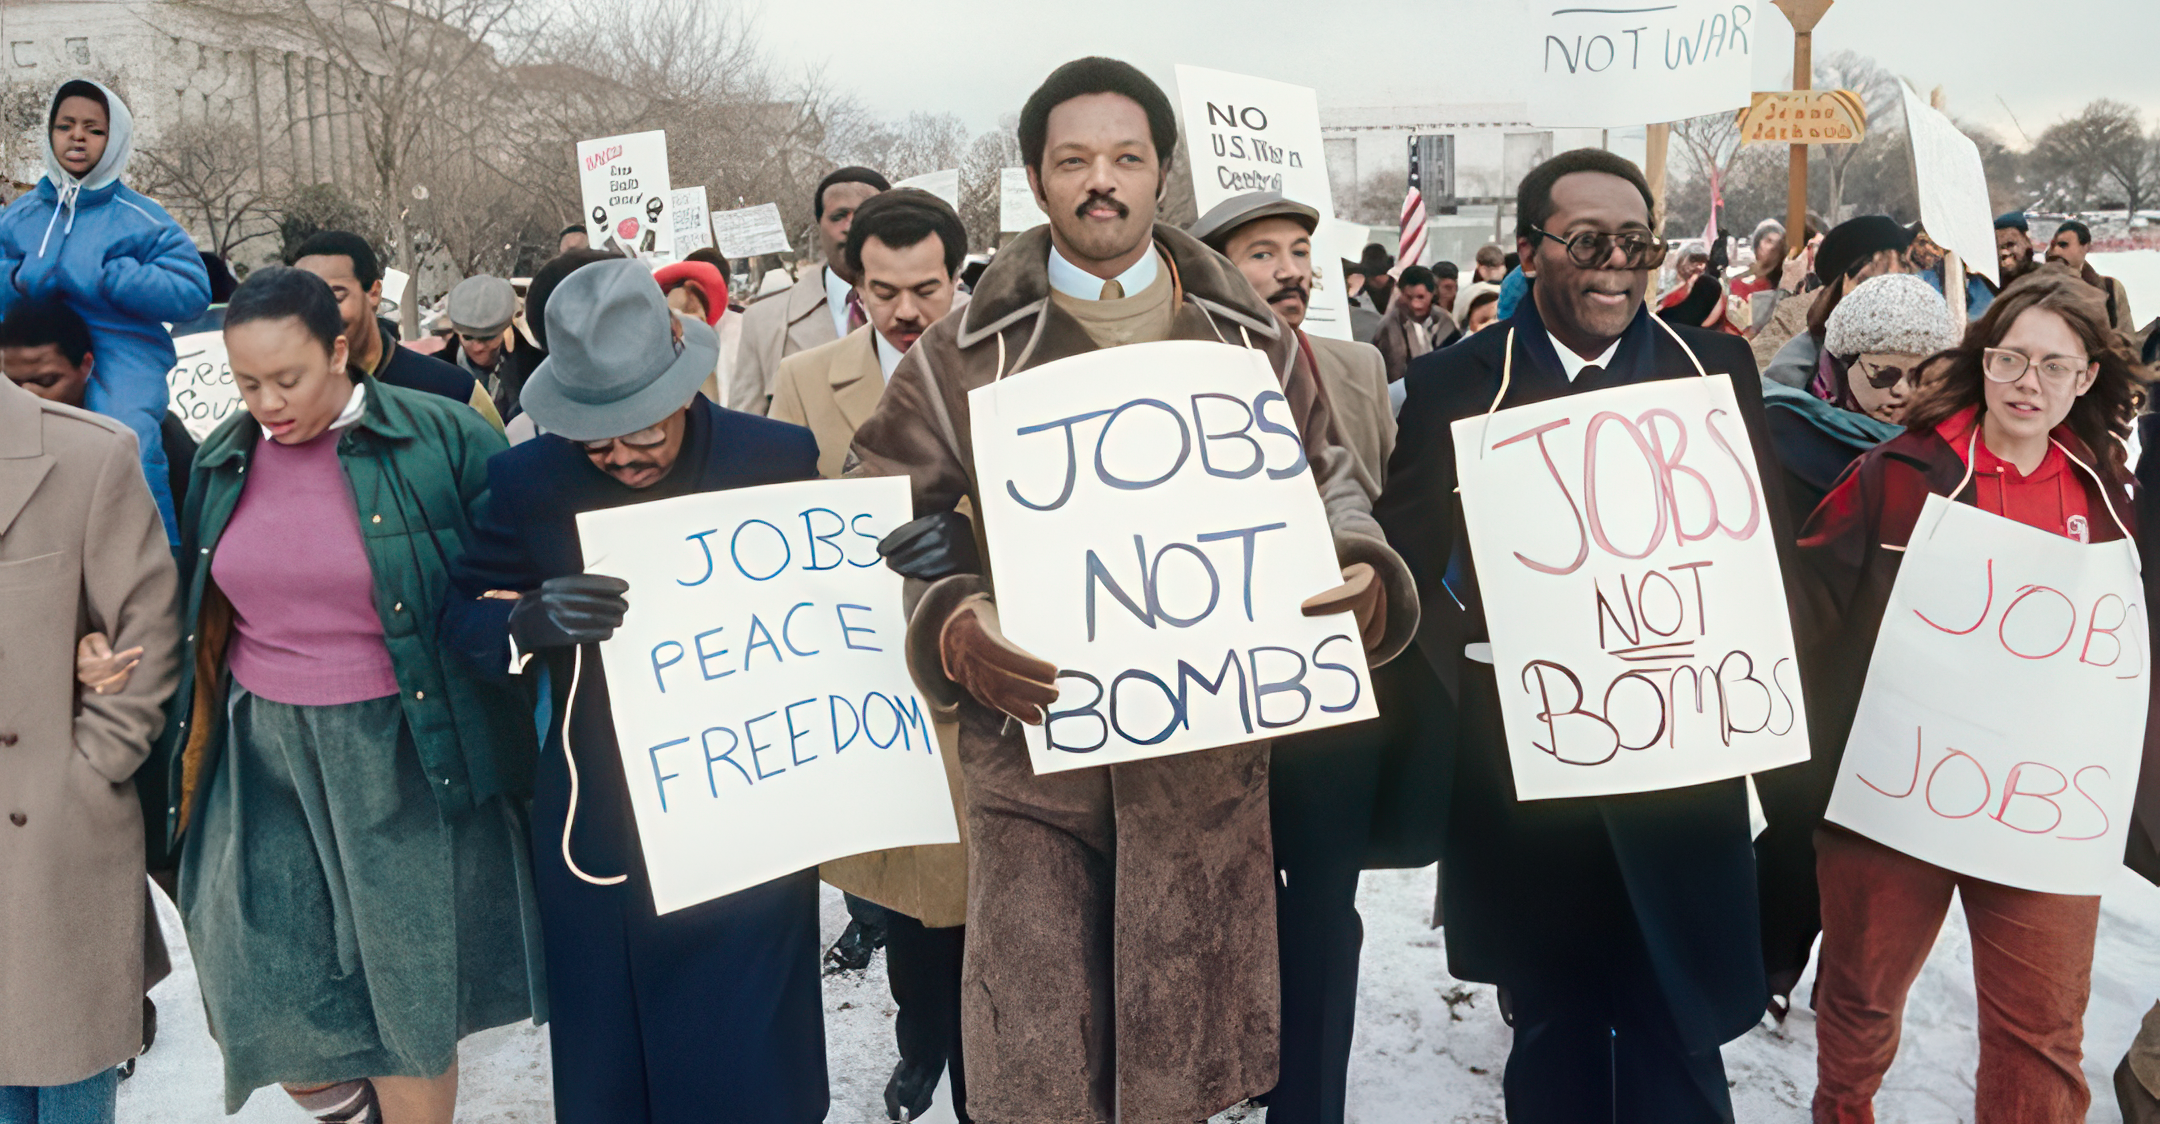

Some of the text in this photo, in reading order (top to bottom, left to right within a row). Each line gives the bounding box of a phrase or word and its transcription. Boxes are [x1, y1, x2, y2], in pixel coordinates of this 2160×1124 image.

[1545, 5, 1751, 74] NOT WAR
[1206, 101, 1268, 131] NO
[1007, 390, 1308, 511] JOBS
[1491, 408, 1760, 575] JOBS
[677, 507, 882, 586] JOBS
[1085, 522, 1287, 643] NOT
[651, 602, 883, 693] PEACE
[1594, 560, 1713, 650] NOT
[1912, 558, 2144, 680] JOBS
[649, 691, 933, 813] FREEDOM
[1045, 634, 1361, 754] BOMBS
[1521, 650, 1794, 766] BOMBS
[1856, 725, 2111, 841] JOBS
